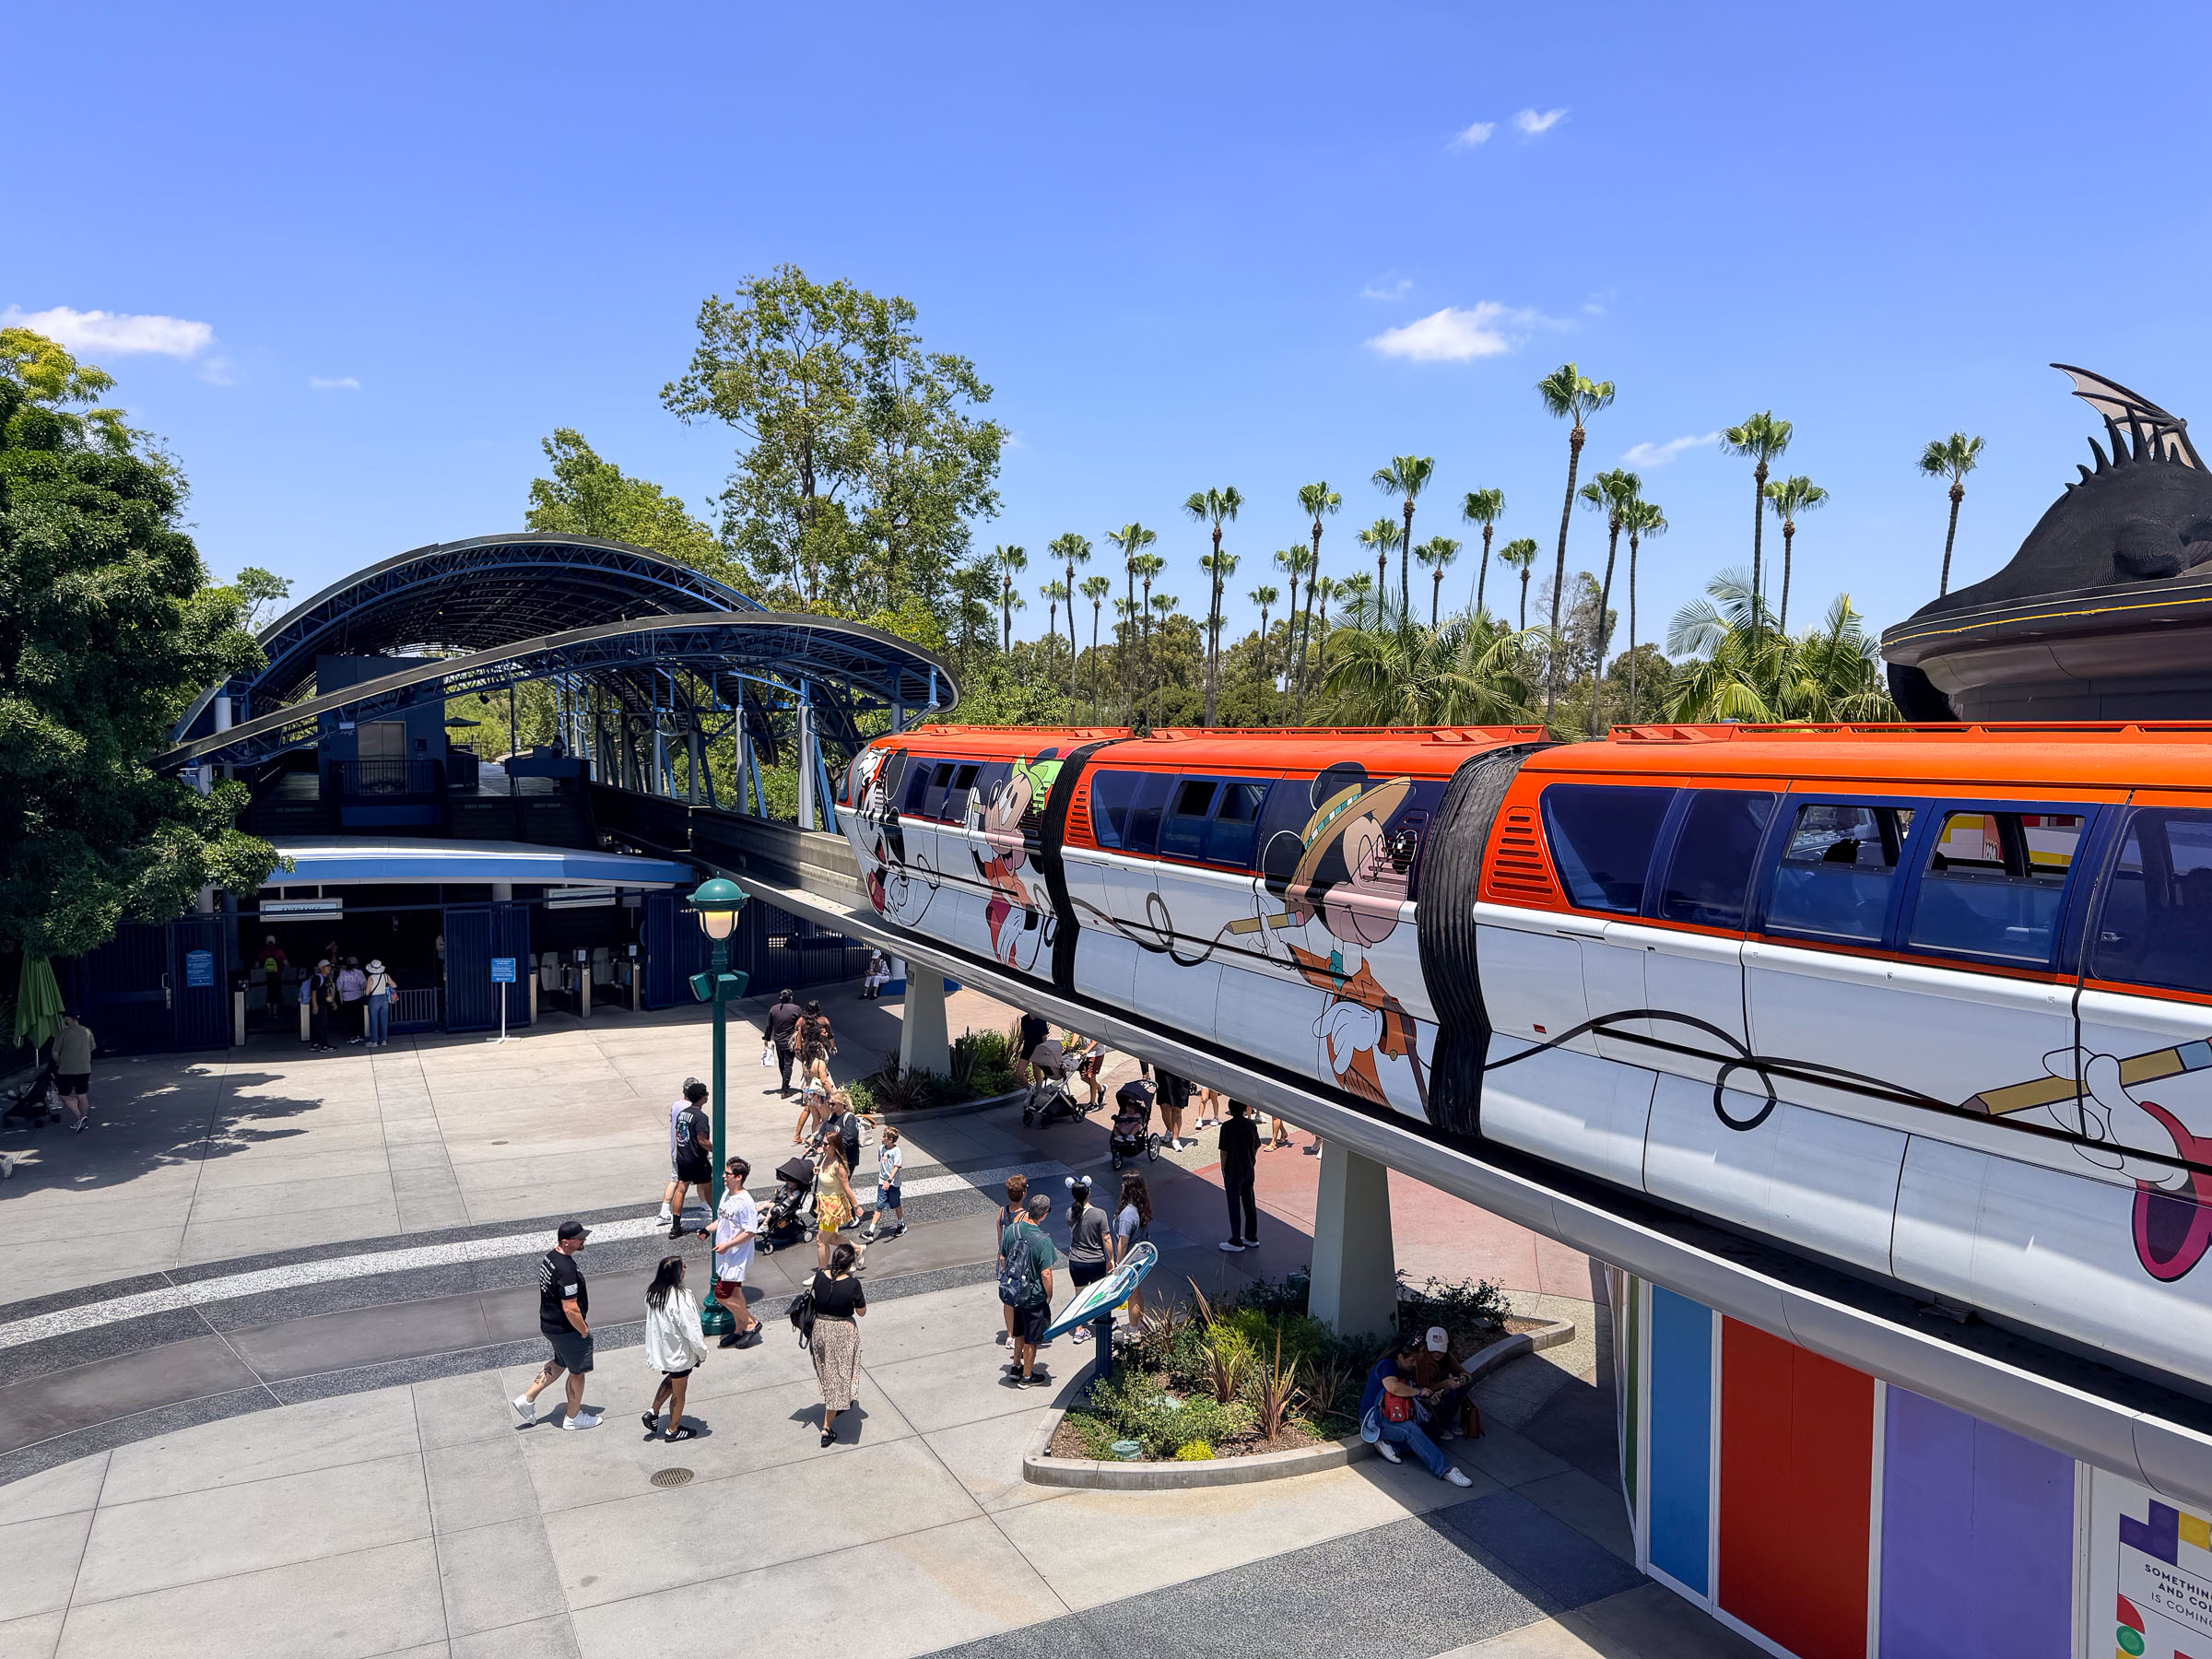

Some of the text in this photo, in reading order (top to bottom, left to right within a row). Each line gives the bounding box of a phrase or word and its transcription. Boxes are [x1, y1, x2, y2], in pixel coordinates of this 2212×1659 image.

[2145, 1564, 2212, 1600] SOMETHIN
[2151, 1593, 2161, 1603] IS
[2159, 1583, 2183, 1598] AND
